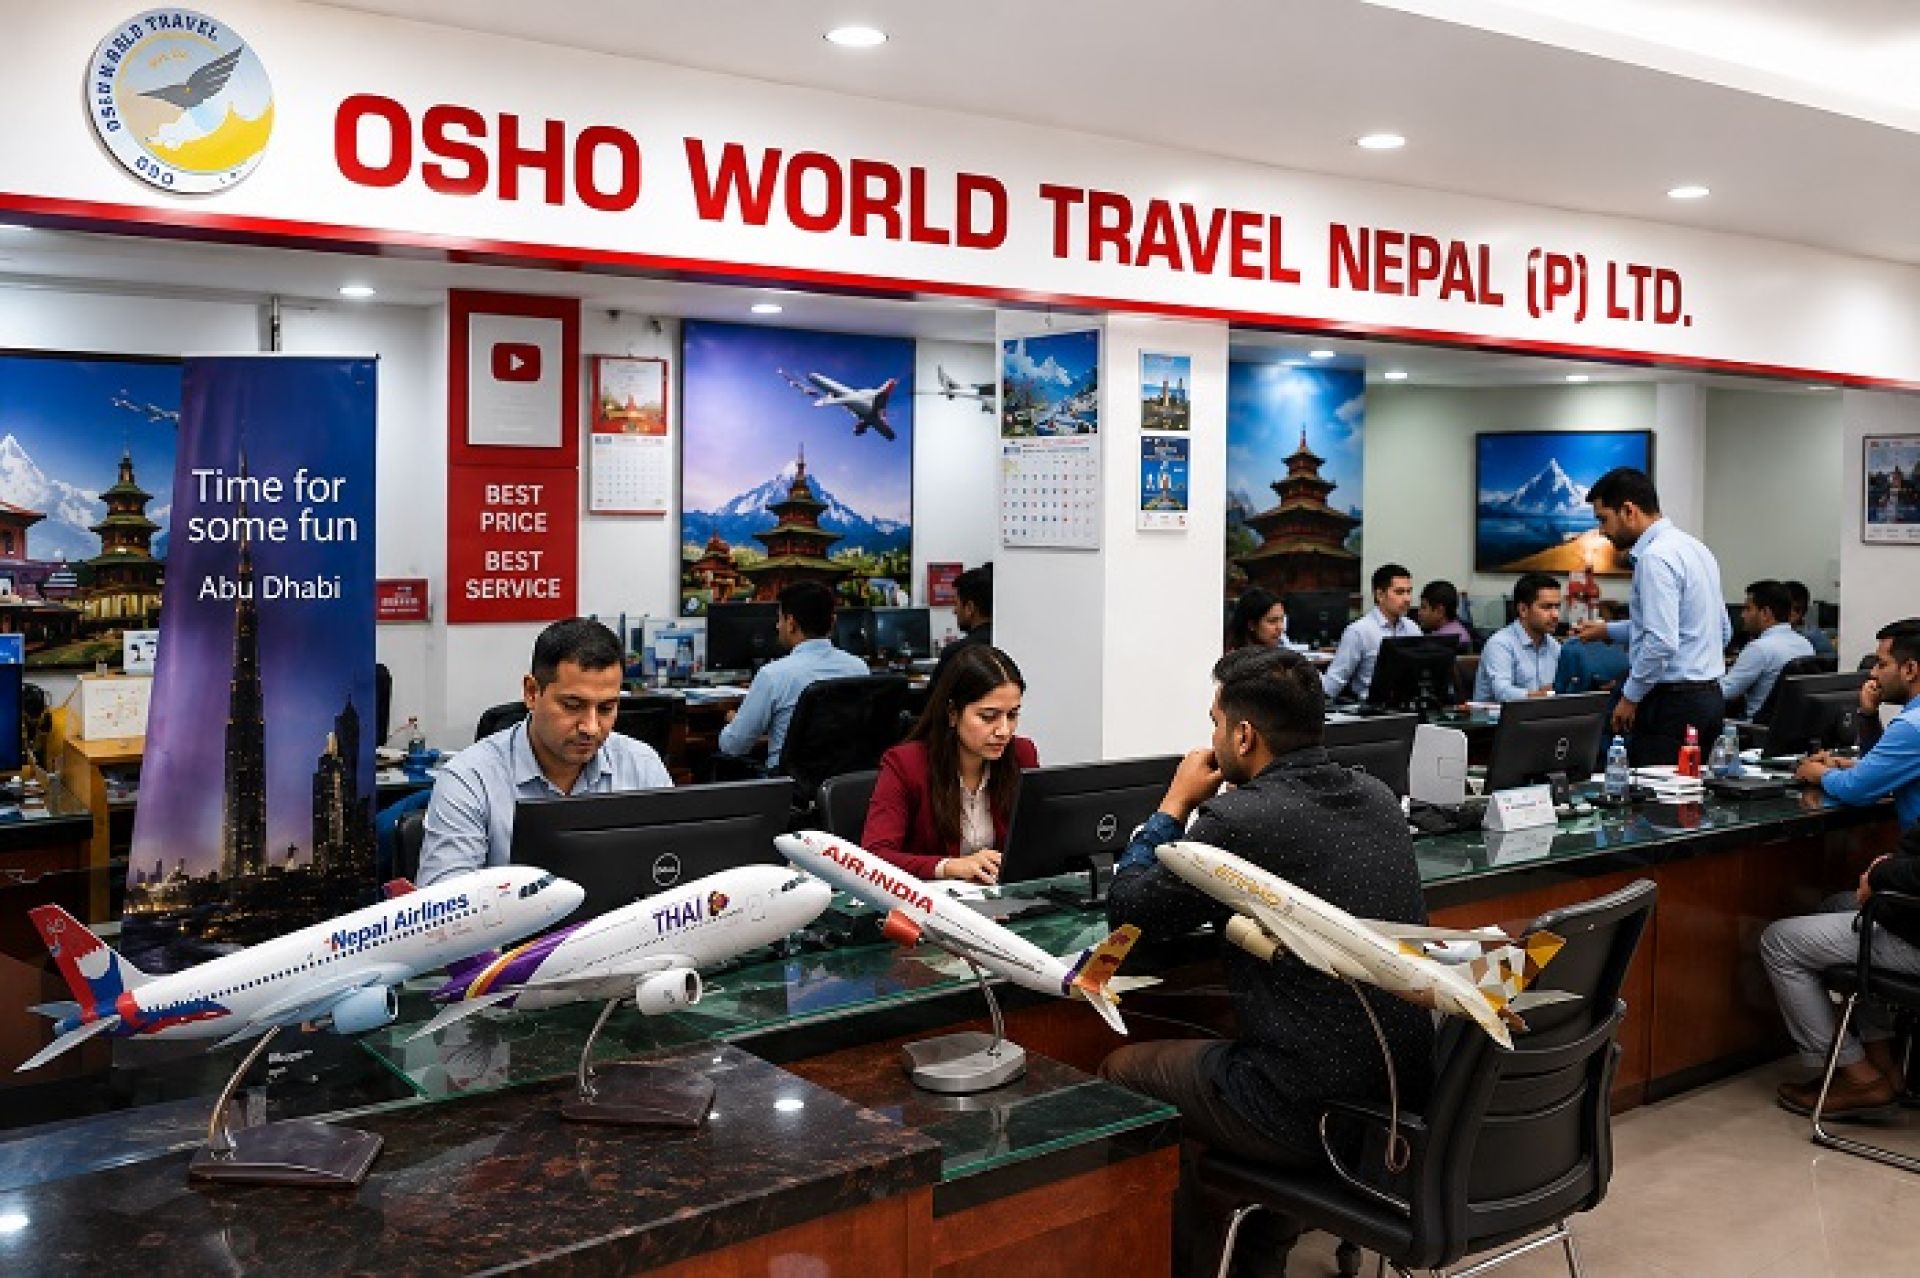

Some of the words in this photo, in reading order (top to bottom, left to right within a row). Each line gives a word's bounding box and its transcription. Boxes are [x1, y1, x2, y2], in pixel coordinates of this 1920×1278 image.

[334, 92, 643, 213] OSHO
[684, 136, 1009, 250] WORLD
[1039, 183, 1301, 285] TRAVEL
[1328, 223, 1505, 307] NEPAL
[1526, 247, 1588, 323] (P)
[1606, 262, 1693, 328] LTD.
[191, 463, 285, 504] Time
[293, 467, 347, 504] for
[485, 484, 545, 506] BEST
[187, 514, 290, 544] some
[297, 506, 359, 543] fun
[480, 511, 548, 535] PRICE
[485, 550, 545, 572] BEST
[199, 574, 255, 601] Abu
[261, 573, 342, 601] Dhabi
[464, 577, 562, 600] SERVICE
[331, 915, 389, 951] Nepal
[394, 893, 470, 931] Airlines
[653, 898, 703, 935] THAI
